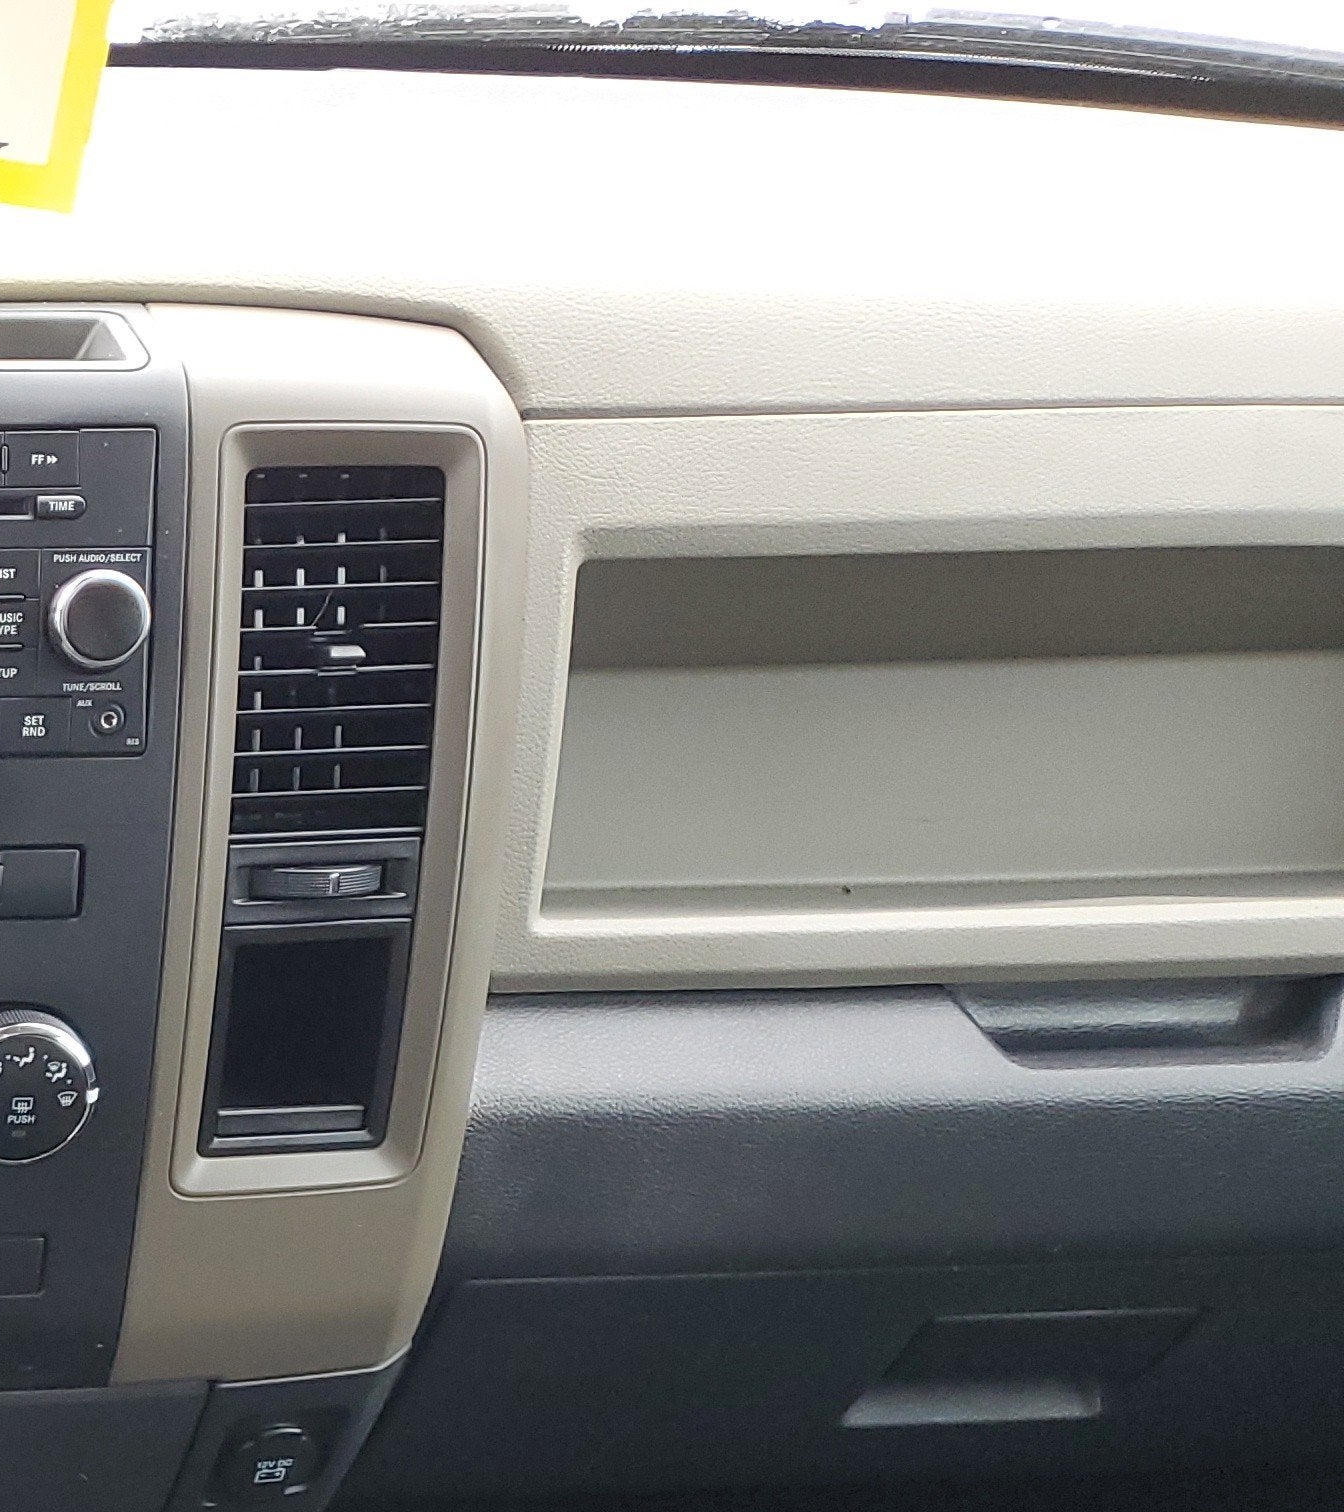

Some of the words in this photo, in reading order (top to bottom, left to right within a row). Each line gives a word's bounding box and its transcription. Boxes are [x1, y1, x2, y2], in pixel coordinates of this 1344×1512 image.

[31, 454, 45, 465] FF
[48, 501, 76, 512] TIME
[53, 553, 76, 563] PUSH
[78, 553, 142, 563] AUDIO/SELECT
[62, 682, 122, 692] TUNE/SCROLL
[23, 715, 45, 725] SET
[22, 726, 46, 737] RND
[8, 1114, 35, 1124] PUSH
